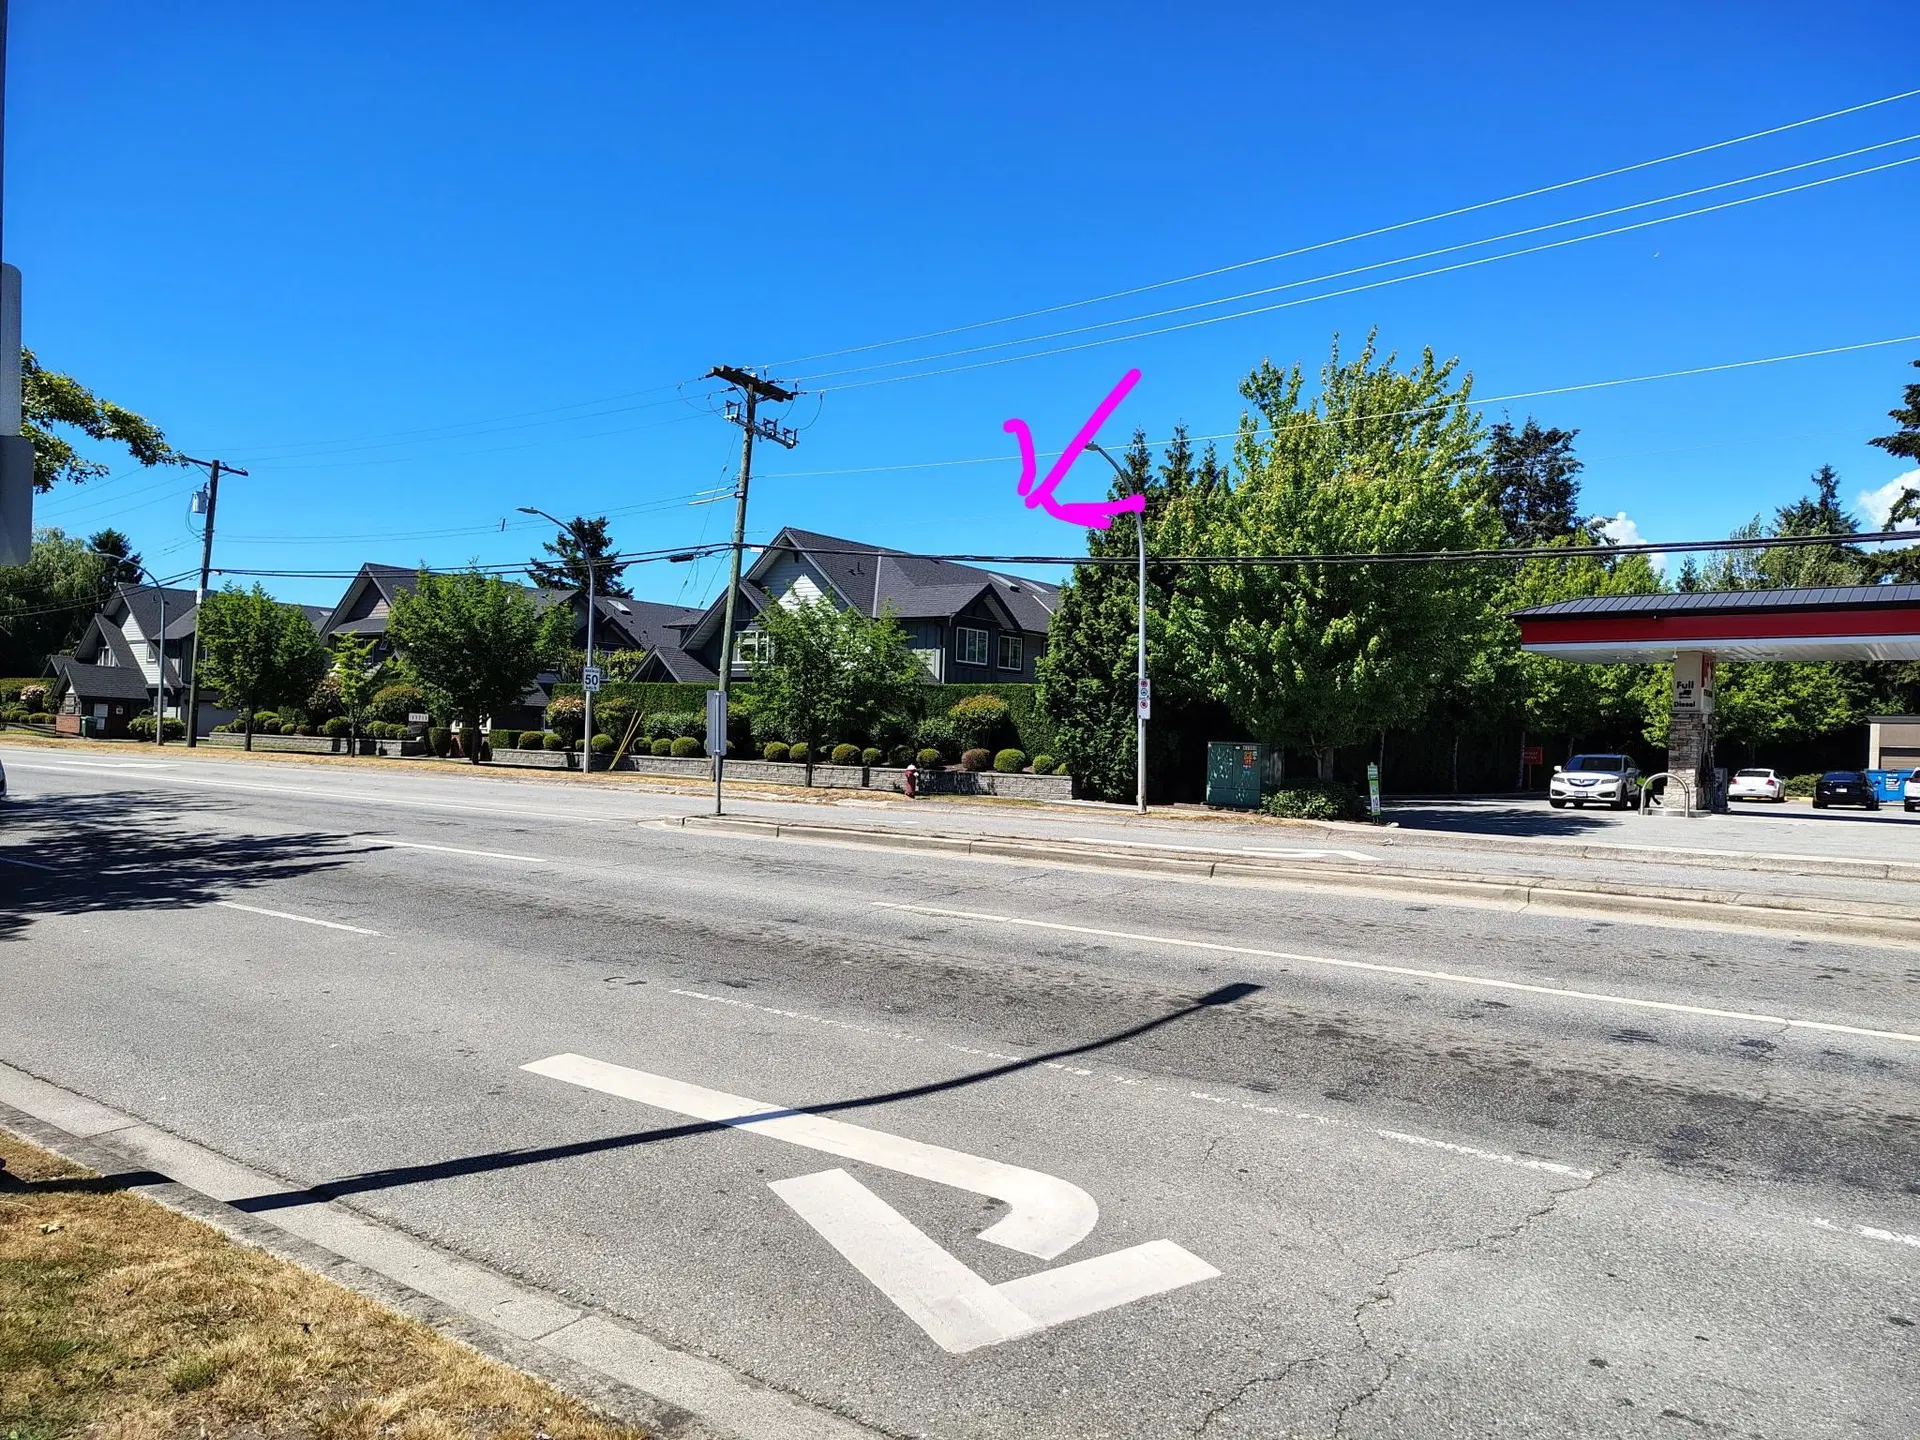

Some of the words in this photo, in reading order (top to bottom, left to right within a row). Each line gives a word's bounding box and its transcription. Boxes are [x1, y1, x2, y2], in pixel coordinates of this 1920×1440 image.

[585, 674, 599, 686] 50
[1676, 680, 1695, 689] Full
[1673, 700, 1696, 708] Diesel
